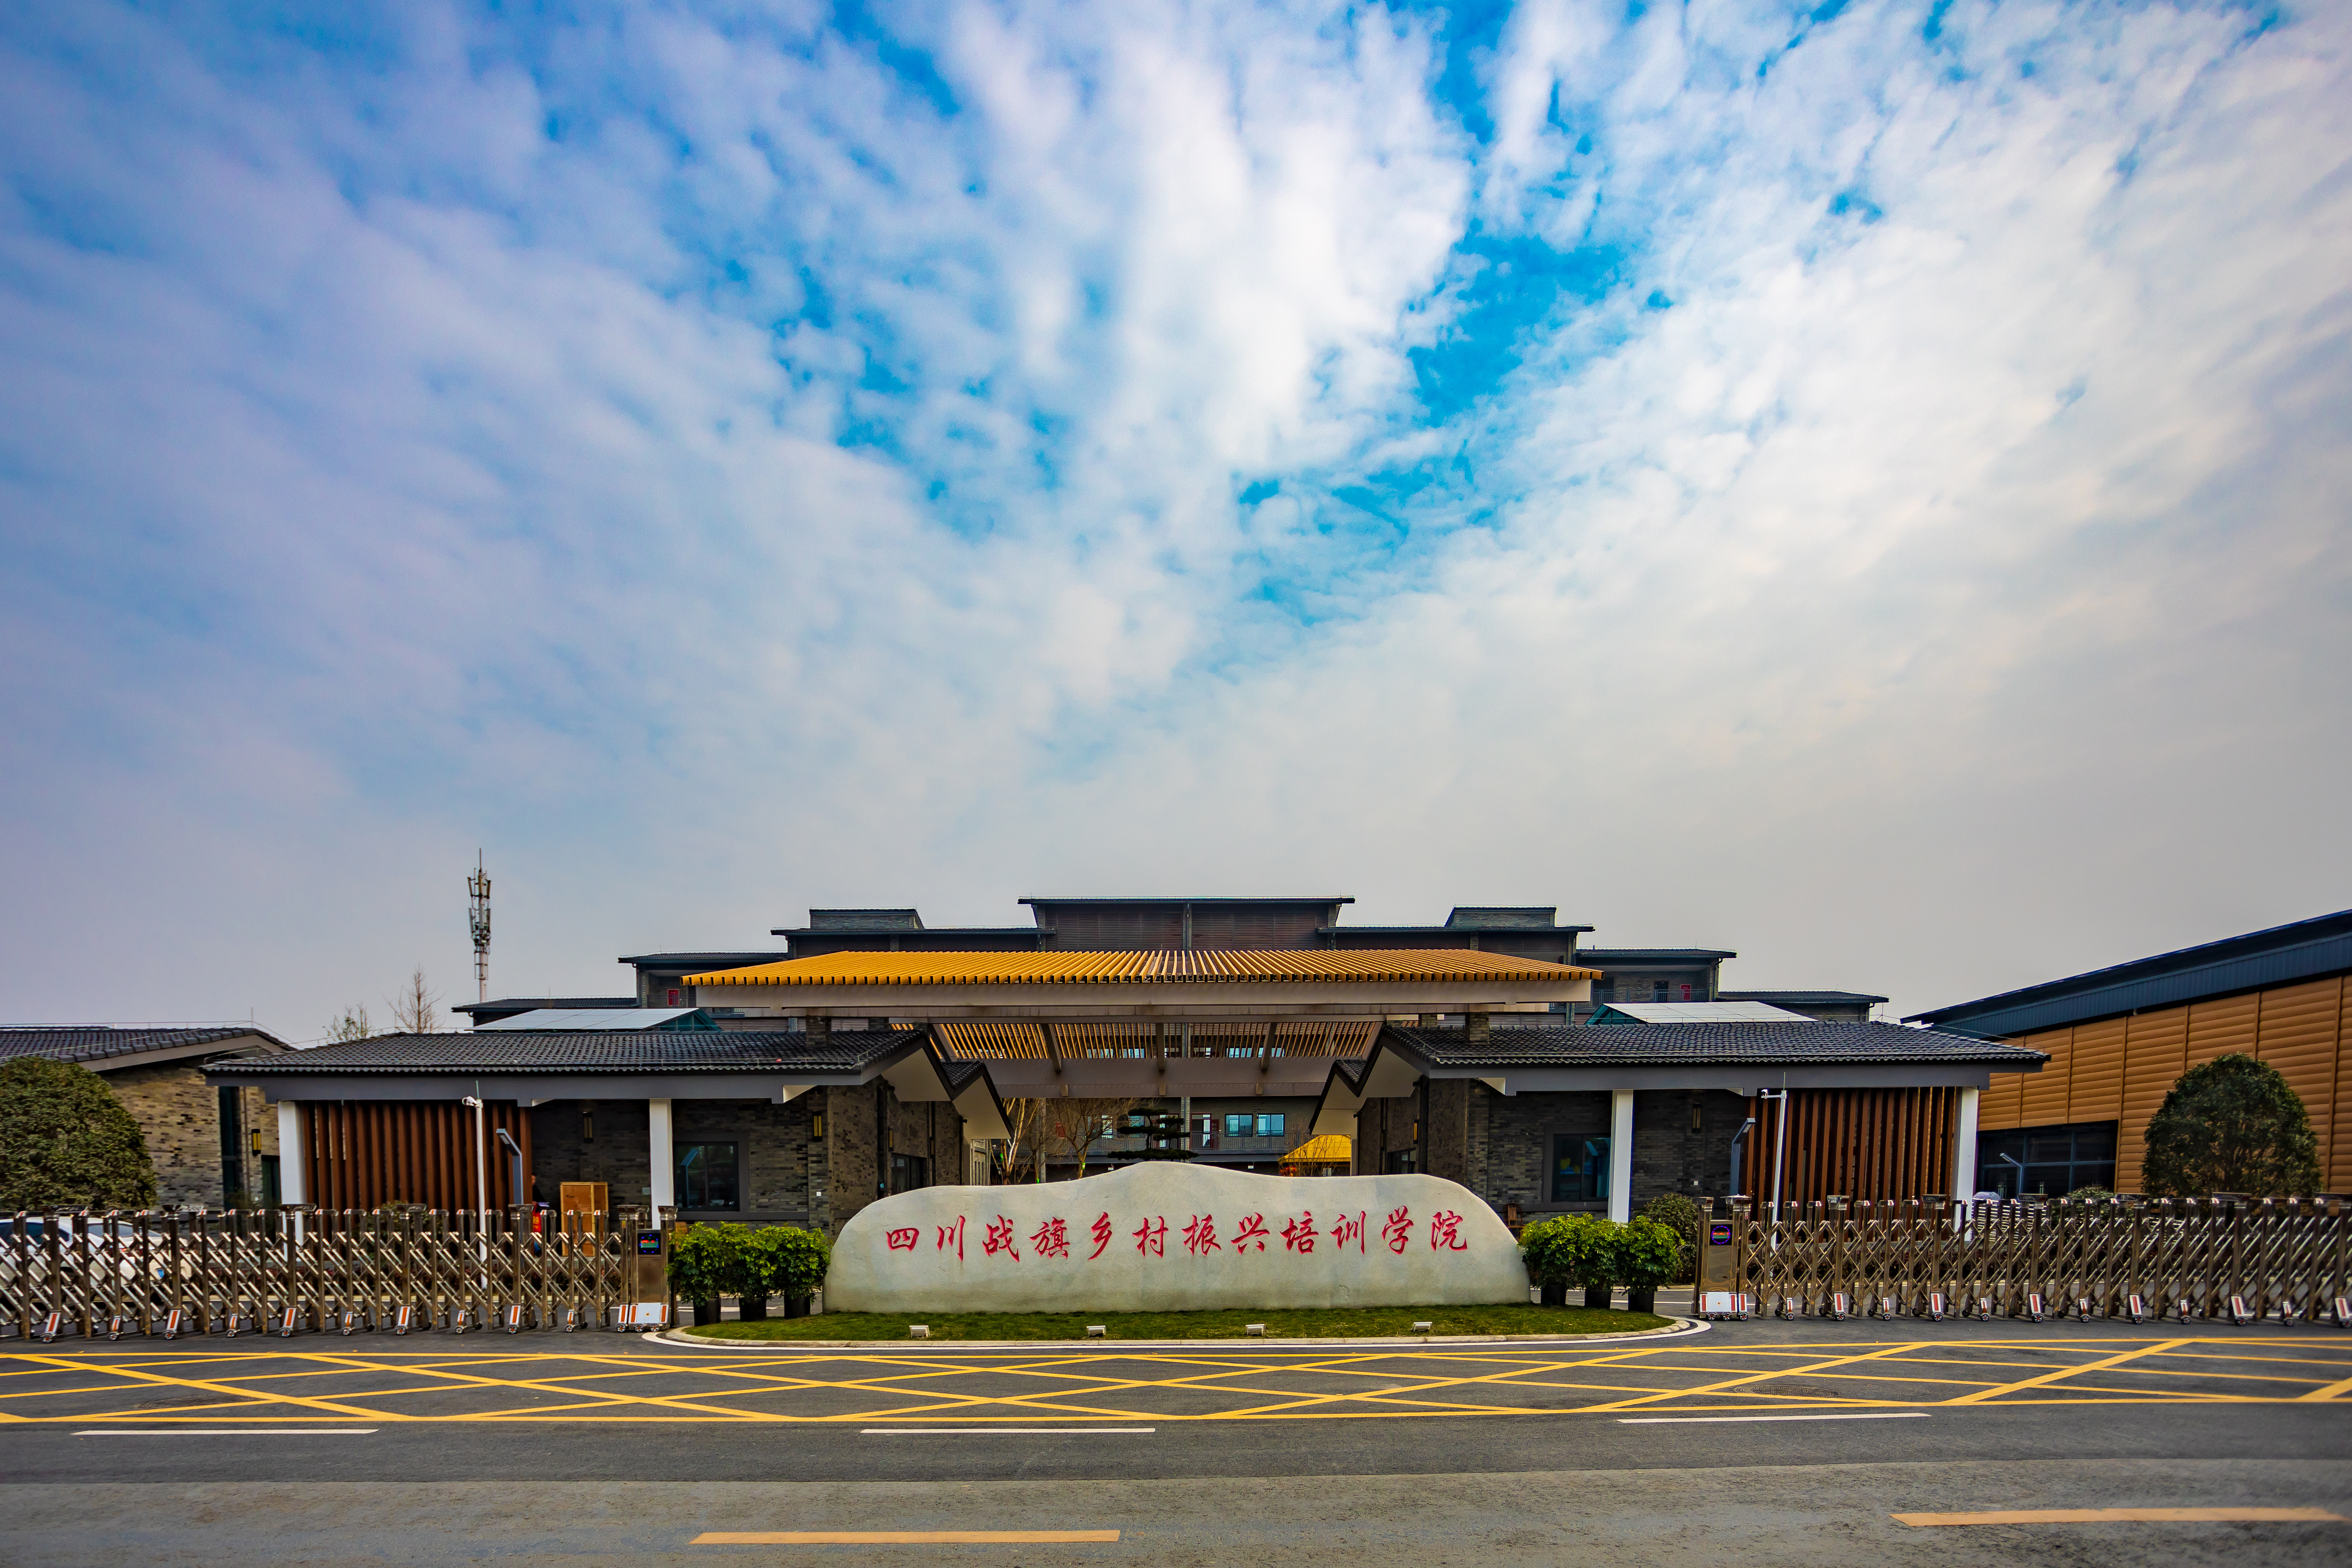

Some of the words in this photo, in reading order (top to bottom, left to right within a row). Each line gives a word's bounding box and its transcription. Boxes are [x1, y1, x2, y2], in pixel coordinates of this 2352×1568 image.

[885, 1205, 1468, 1262] 四川战旗乡村振兴培训学院
